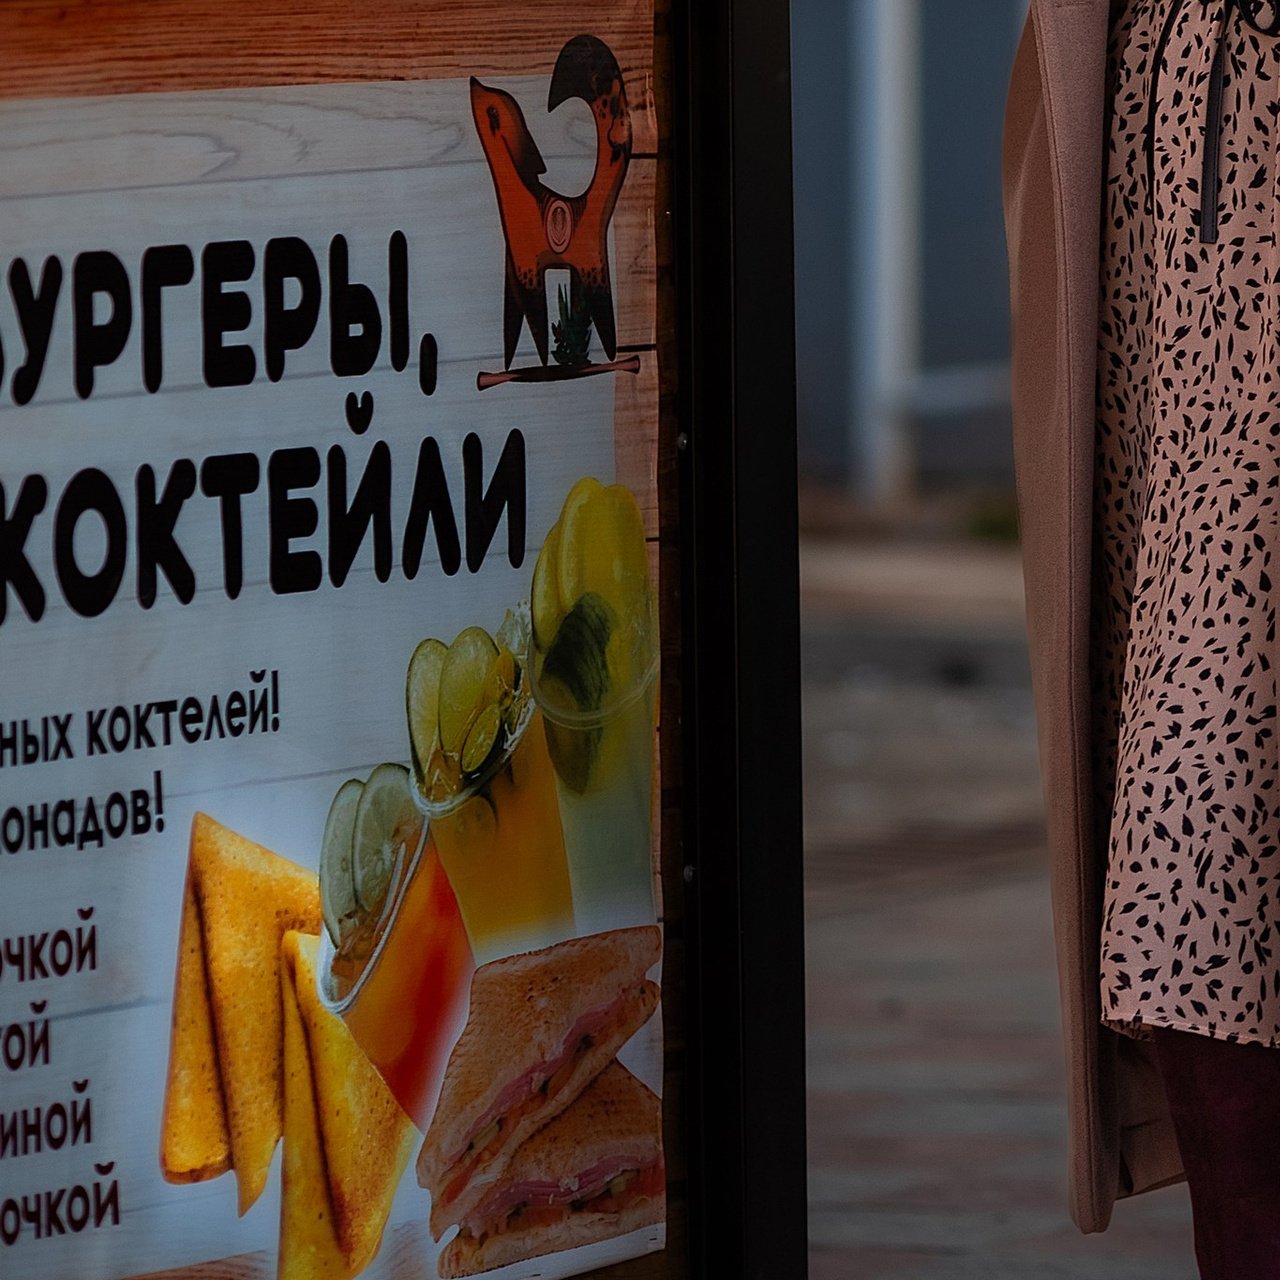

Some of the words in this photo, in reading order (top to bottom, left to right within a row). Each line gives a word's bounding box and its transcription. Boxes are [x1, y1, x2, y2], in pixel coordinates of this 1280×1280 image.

[0, 230, 438, 407] УРГЕРЫ,
[0, 391, 526, 626] КОКТЕЙЛИ
[87, 670, 281, 757] коктелей!
[0, 770, 165, 855] онадов!
[0, 906, 97, 982] чкой
[0, 999, 50, 1071] ой
